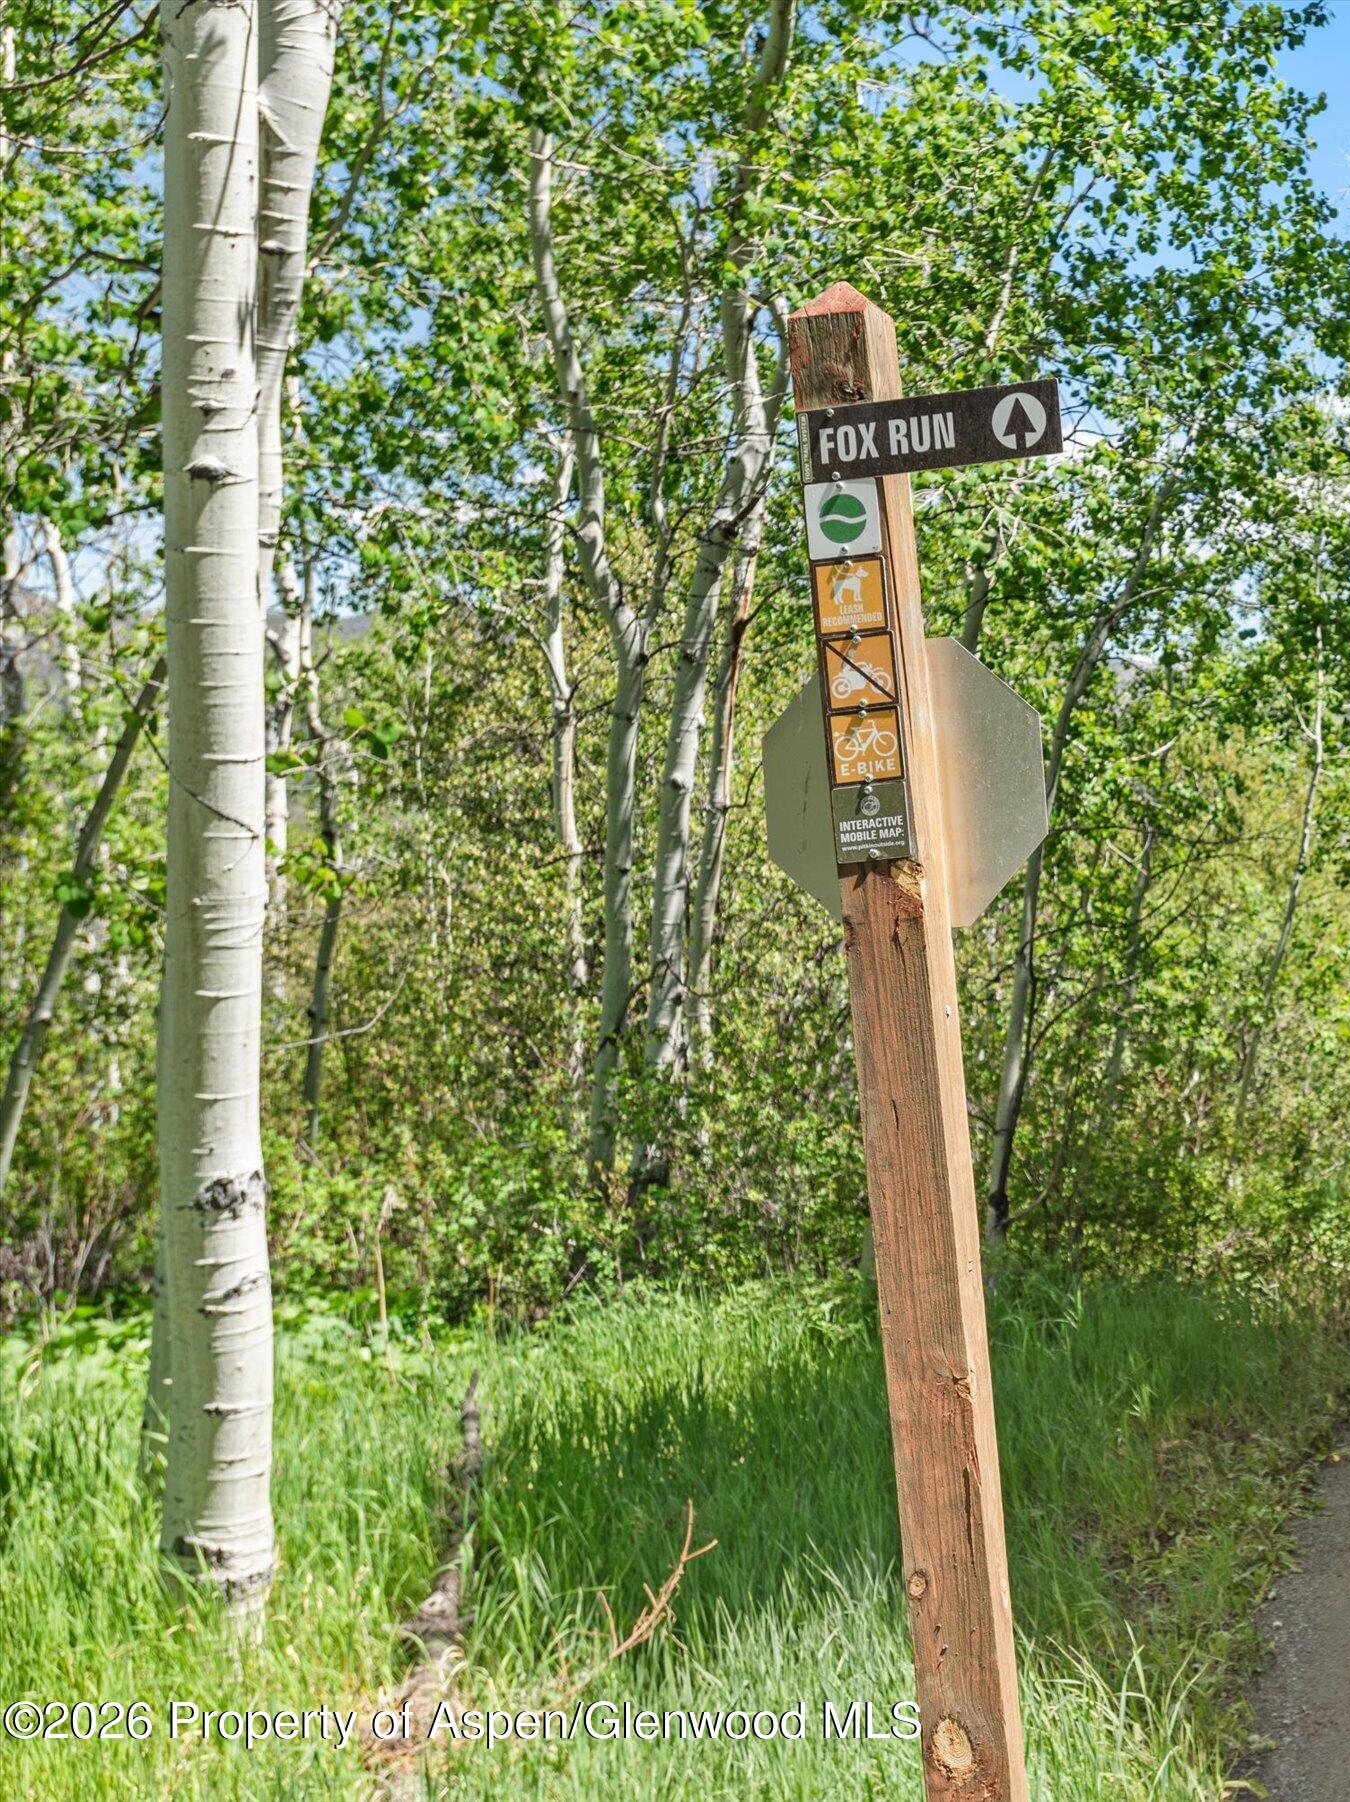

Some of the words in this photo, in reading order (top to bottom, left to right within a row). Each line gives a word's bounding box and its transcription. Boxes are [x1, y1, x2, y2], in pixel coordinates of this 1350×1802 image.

[819, 421, 880, 465] FOX
[888, 411, 956, 456] RUN
[840, 603, 864, 615] LEASH
[822, 612, 883, 627] RECOMMENDED
[840, 758, 896, 777] E-BIKE
[839, 815, 904, 832] INTERACTIVE
[840, 829, 877, 843] MOBILE
[879, 826, 905, 840] MAP:
